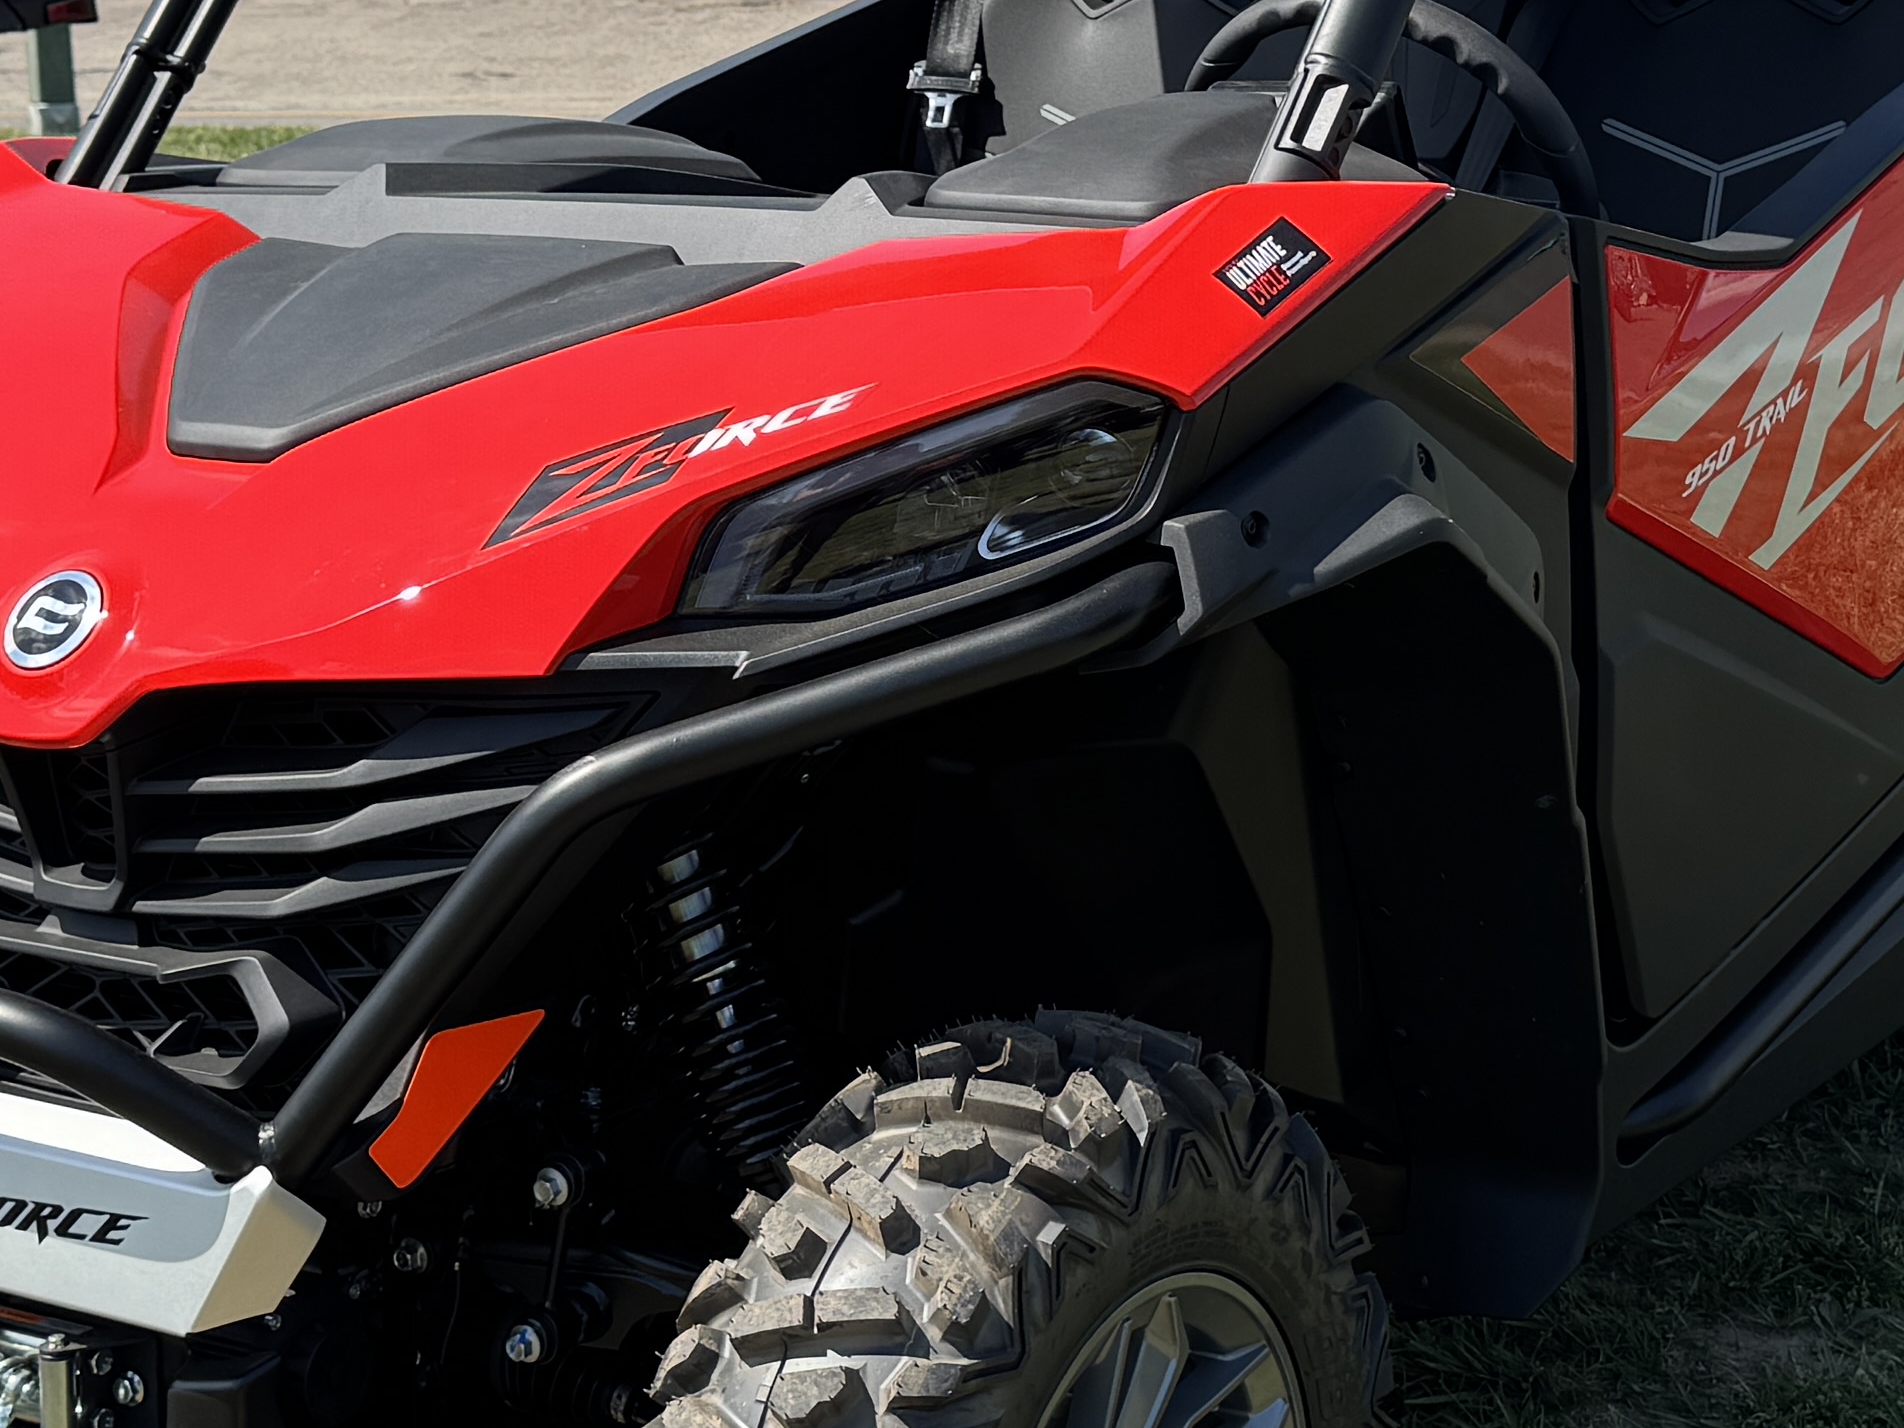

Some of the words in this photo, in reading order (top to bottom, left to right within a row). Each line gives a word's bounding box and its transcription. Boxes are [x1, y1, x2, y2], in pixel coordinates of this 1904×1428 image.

[1225, 235, 1287, 291] ULTIMATE
[1247, 265, 1290, 307] CYCLE
[1682, 436, 1736, 497] 950
[1743, 379, 1808, 448] TRAIL
